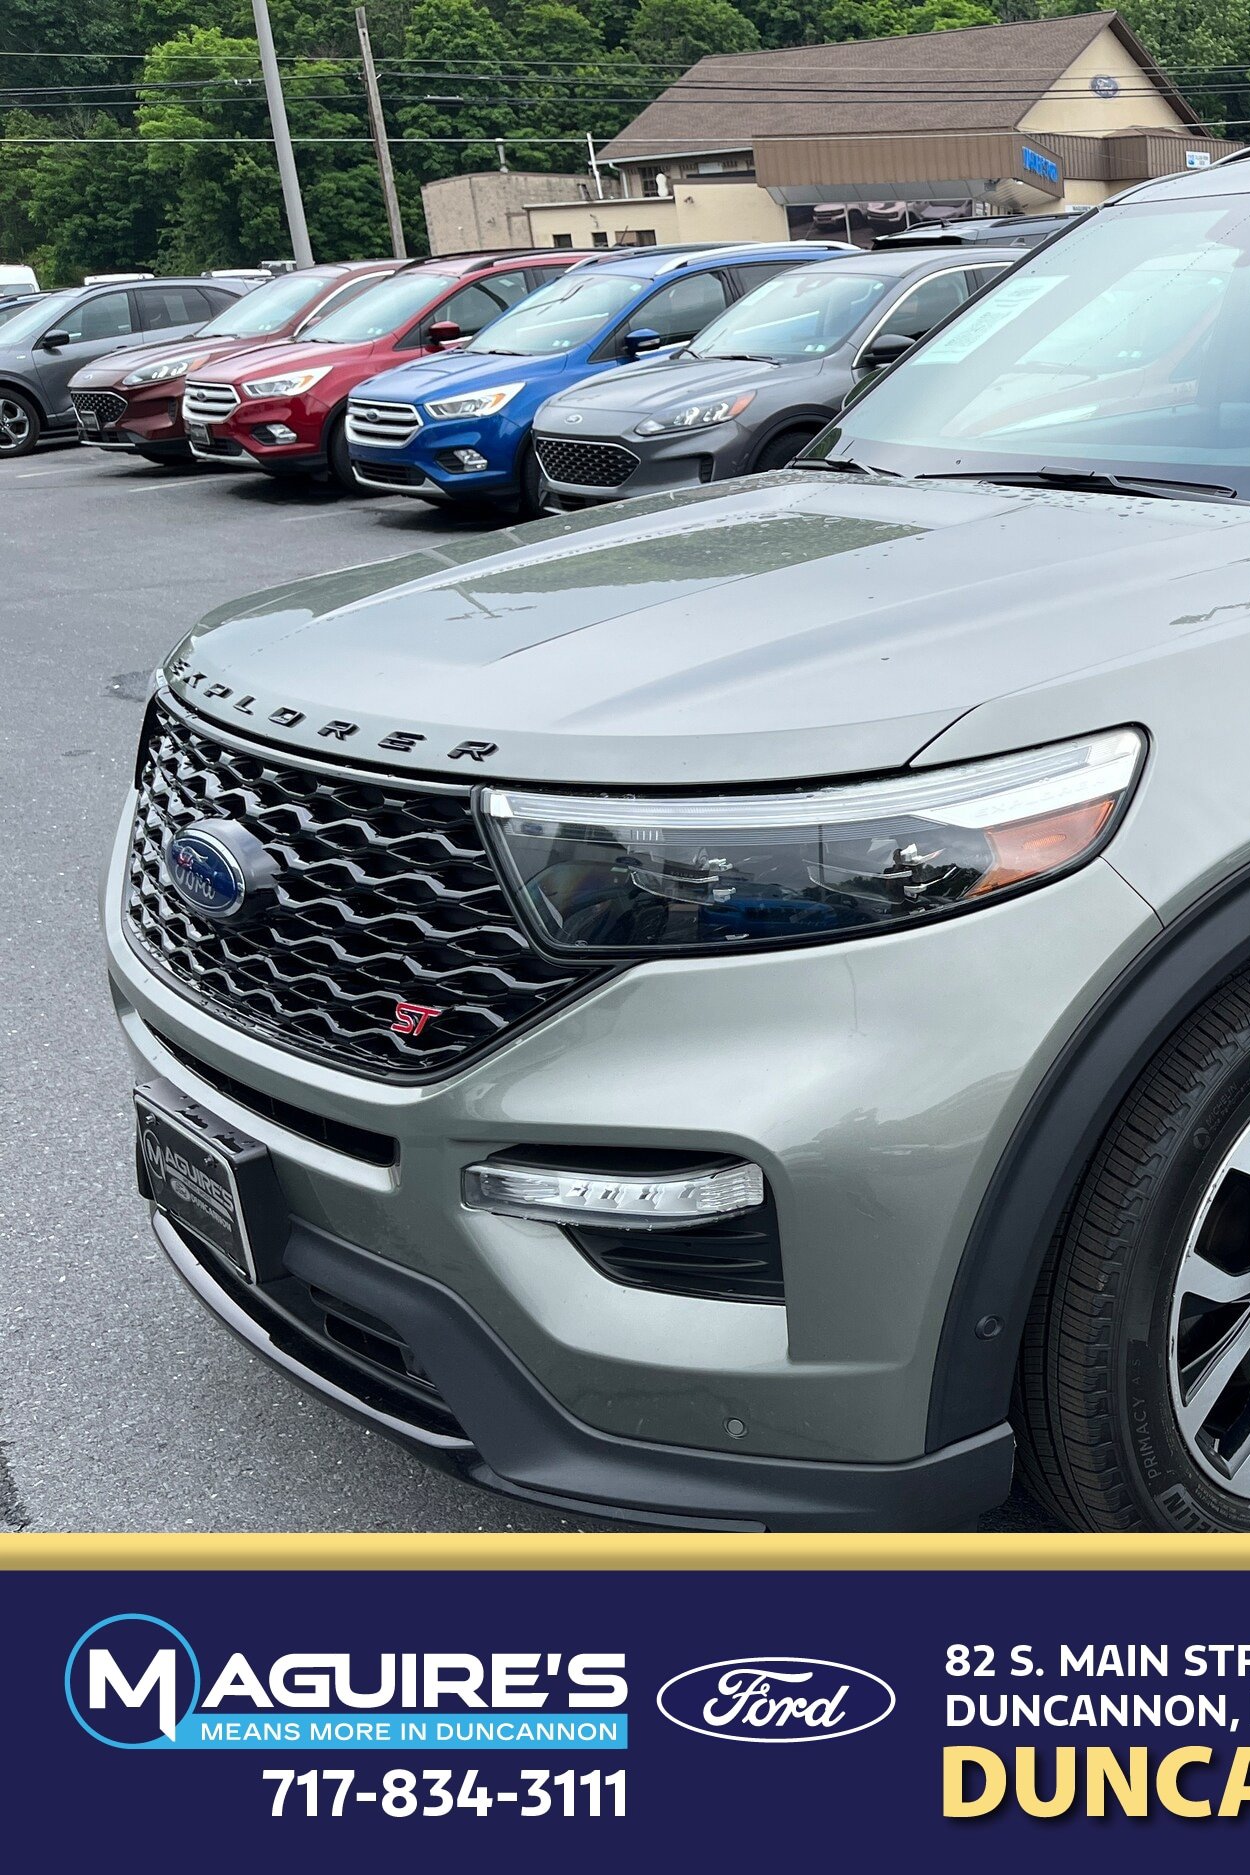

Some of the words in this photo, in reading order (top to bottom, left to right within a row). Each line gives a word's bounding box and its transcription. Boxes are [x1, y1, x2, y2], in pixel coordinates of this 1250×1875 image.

[169, 658, 500, 761] EXPLORER
[172, 844, 221, 901] Ford
[390, 1002, 442, 1036] ST
[1132, 1396, 1161, 1481] PRIMACY
